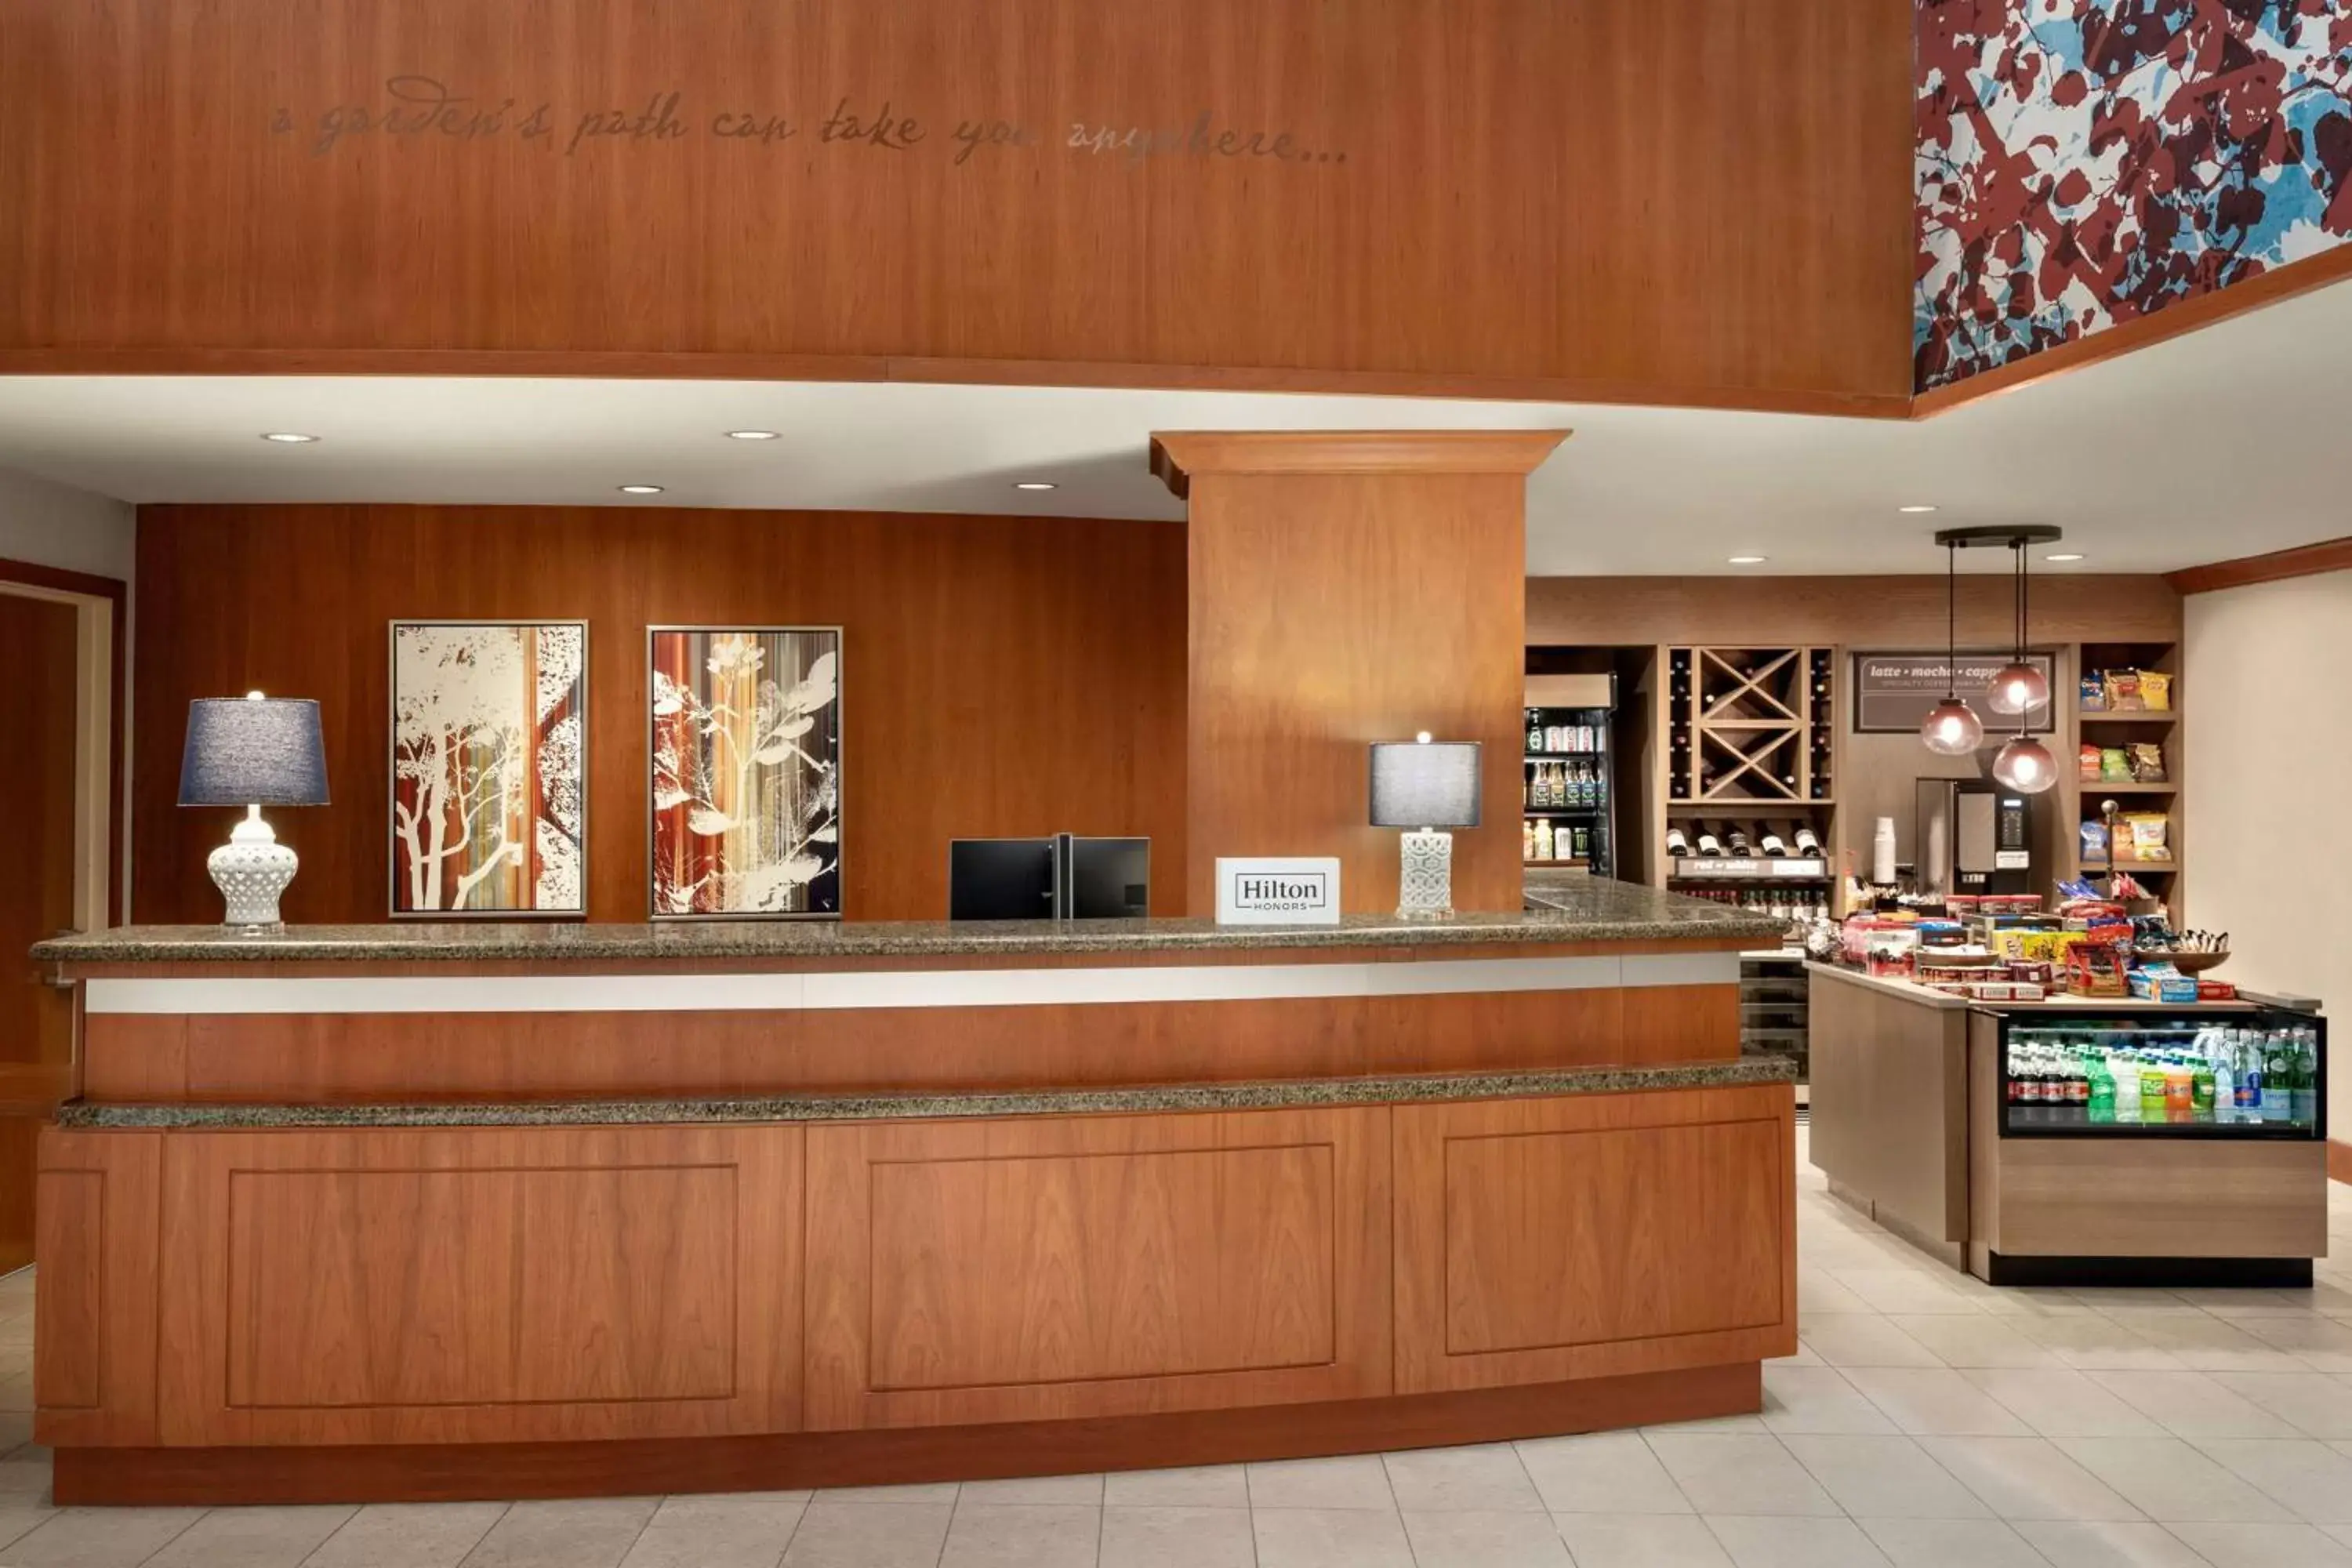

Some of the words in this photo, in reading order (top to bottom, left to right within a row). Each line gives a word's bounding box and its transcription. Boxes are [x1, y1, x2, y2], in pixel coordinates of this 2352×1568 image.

[272, 107, 292, 133] a
[311, 74, 551, 154] garden's
[564, 91, 691, 155] path
[713, 112, 797, 146] can
[818, 96, 927, 151] take
[1067, 108, 1347, 165] anyhere...
[1870, 666, 1902, 677] latte
[1244, 880, 1318, 900] Hilton
[1254, 902, 1308, 911] HONORS
